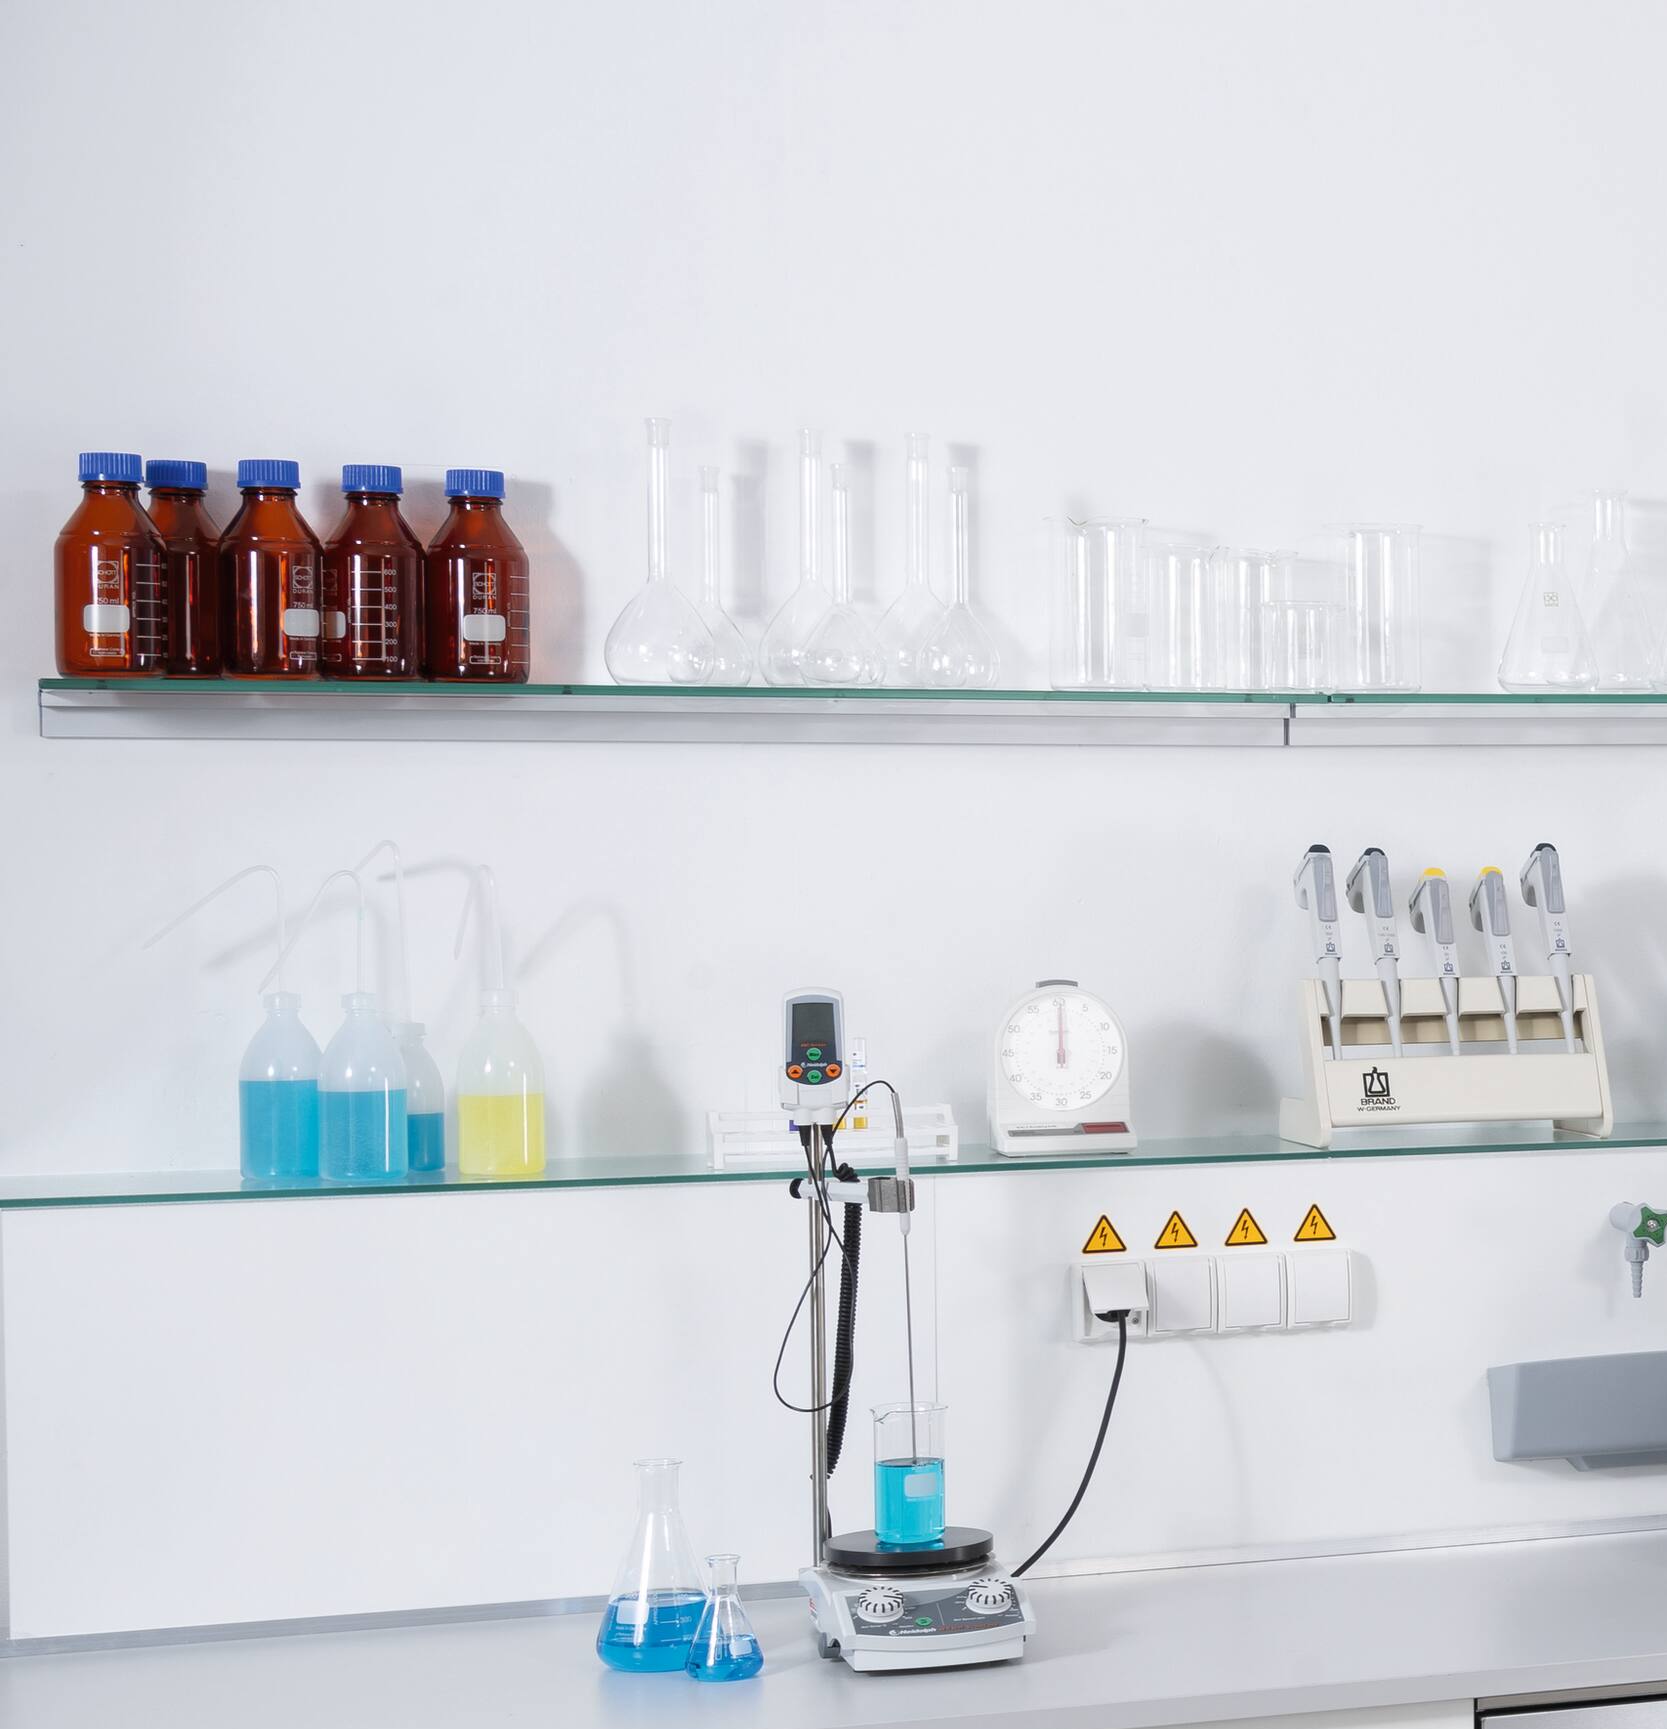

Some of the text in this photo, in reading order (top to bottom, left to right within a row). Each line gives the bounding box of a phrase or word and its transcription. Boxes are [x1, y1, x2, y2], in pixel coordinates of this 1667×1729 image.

[1027, 1005, 1040, 1014] 55
[1082, 1004, 1089, 1012] 5
[1007, 1025, 1021, 1033] 50
[1100, 1023, 1110, 1031] 10
[1002, 1049, 1015, 1057] 45
[1107, 1046, 1118, 1055] 15
[1009, 1074, 1022, 1082] 40
[1100, 1071, 1112, 1080] 20
[1030, 1093, 1042, 1101] 35
[1079, 1091, 1092, 1100] 25
[1055, 1098, 1067, 1106] 30
[1360, 1097, 1396, 1106] BRAND
